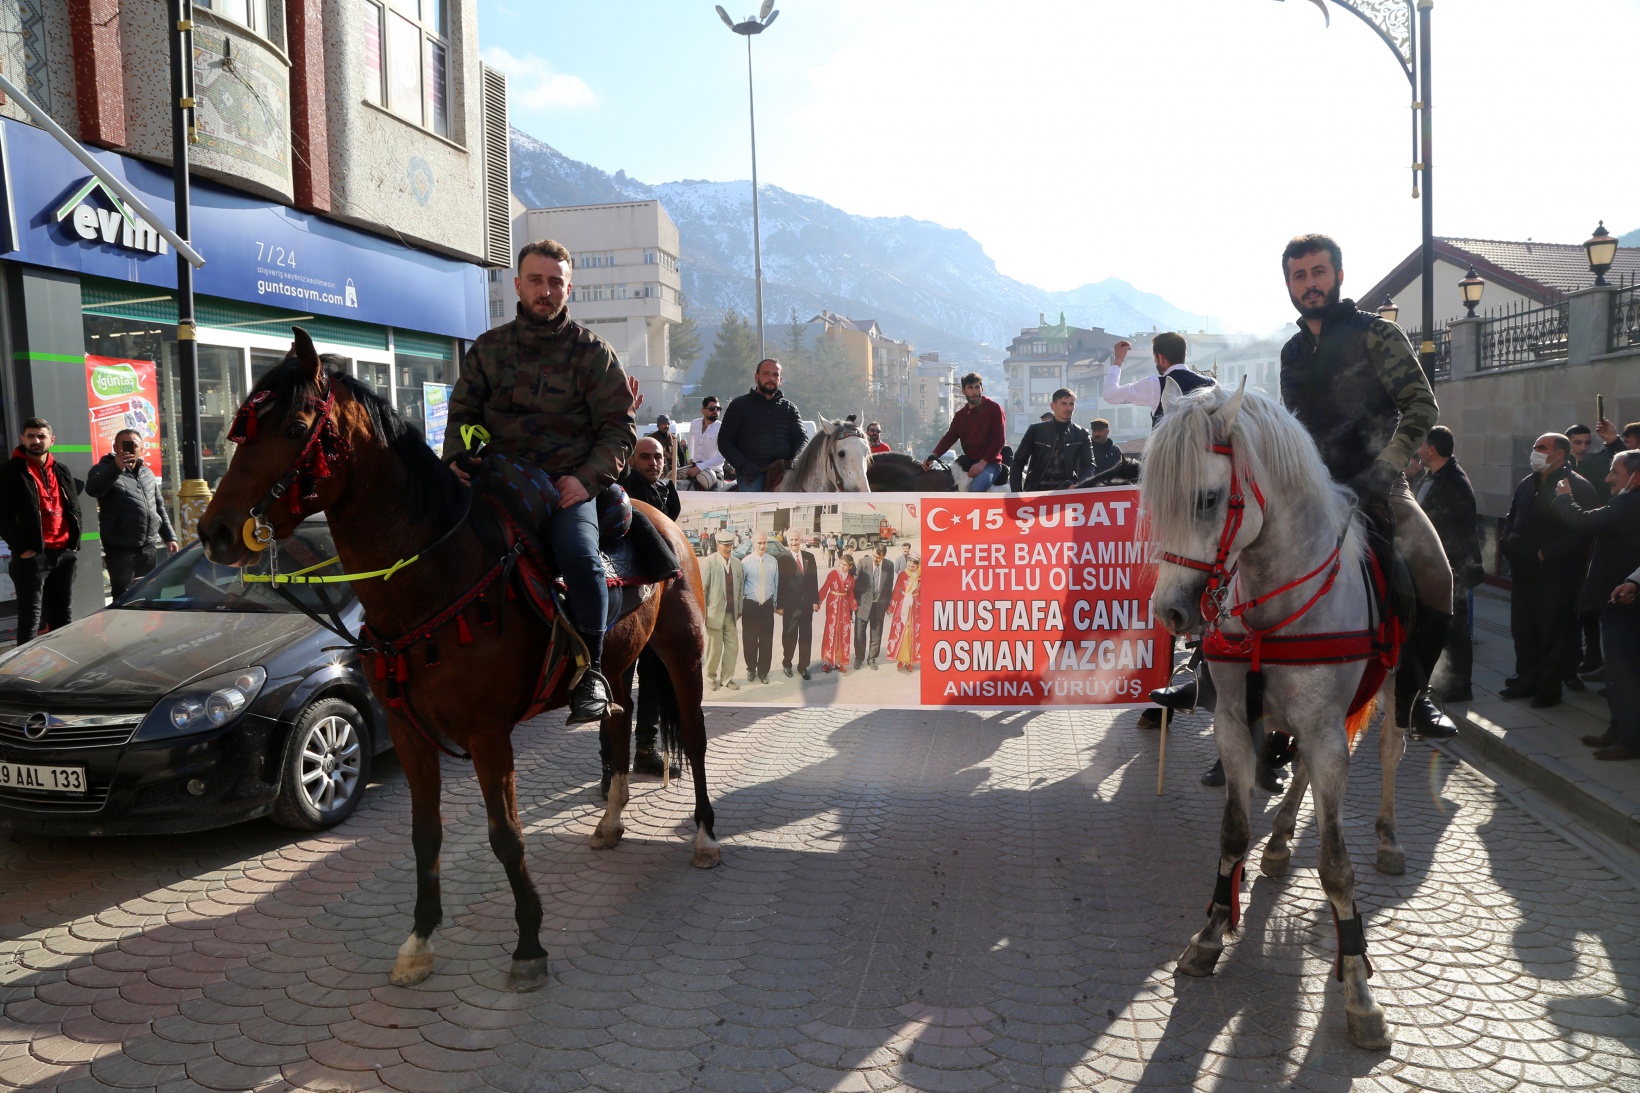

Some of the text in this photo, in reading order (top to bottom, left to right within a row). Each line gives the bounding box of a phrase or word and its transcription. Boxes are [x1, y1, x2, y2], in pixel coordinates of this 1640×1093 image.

[73, 201, 168, 255] evim
[255, 241, 296, 268] 7/24
[257, 280, 344, 305] guntasavm.com
[99, 374, 134, 391] güntaş
[966, 502, 1131, 535] 15 ŞUBAT
[928, 544, 1005, 567] ZAFER
[961, 567, 1130, 591] KUTLU OLSUN
[933, 599, 1155, 631] MUSTAFA CANLI
[933, 639, 1154, 671] OSMAN YAZGAN
[944, 676, 1142, 698] ANISINA YÜRÜYÜŞ
[0, 765, 81, 789] 9 AAL 133
